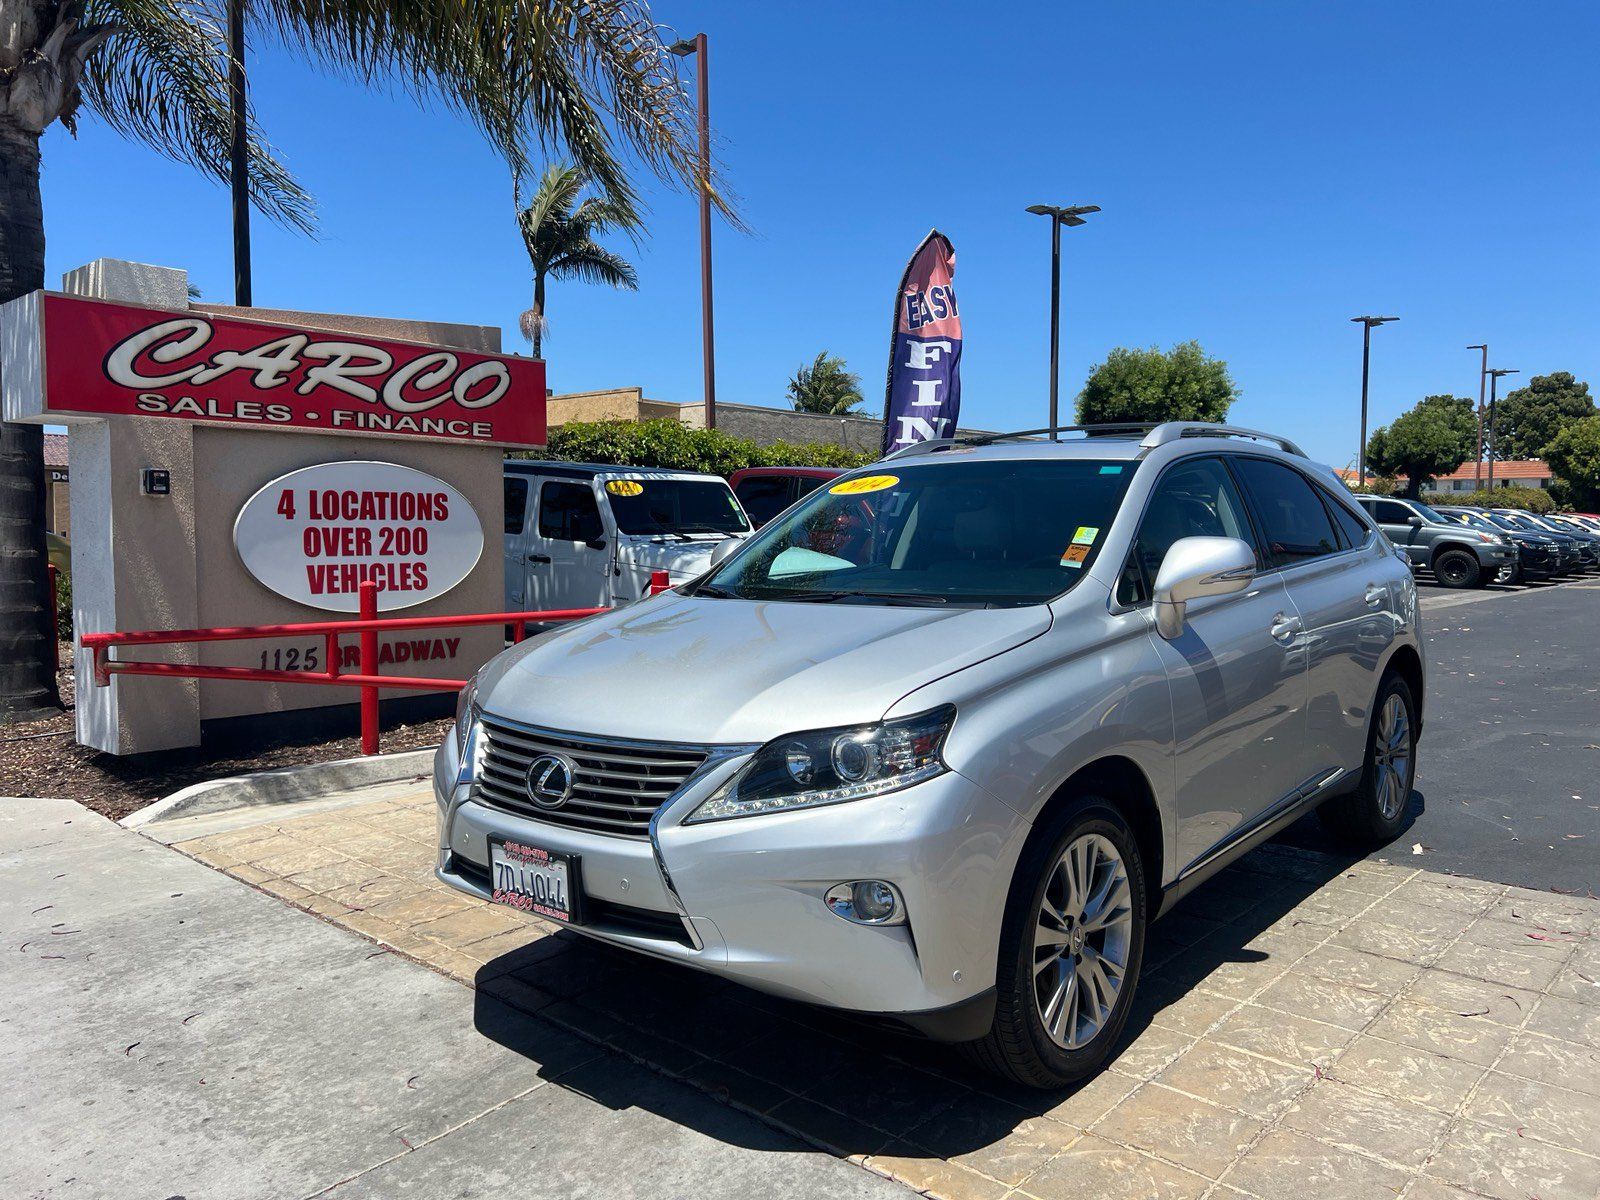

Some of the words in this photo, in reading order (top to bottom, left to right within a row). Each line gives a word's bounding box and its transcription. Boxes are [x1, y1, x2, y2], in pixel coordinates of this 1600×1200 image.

[905, 284, 959, 330] EASY
[106, 318, 511, 413] CARCO
[137, 392, 292, 422] SALES
[332, 409, 493, 438] FINANCE
[277, 489, 296, 520] 4
[309, 489, 449, 521] LOCATIONS
[303, 526, 372, 557] OVER
[378, 526, 428, 556] 200
[306, 562, 428, 594] VEHICLES
[260, 646, 318, 672] 1125
[336, 637, 461, 668] RADWAY
